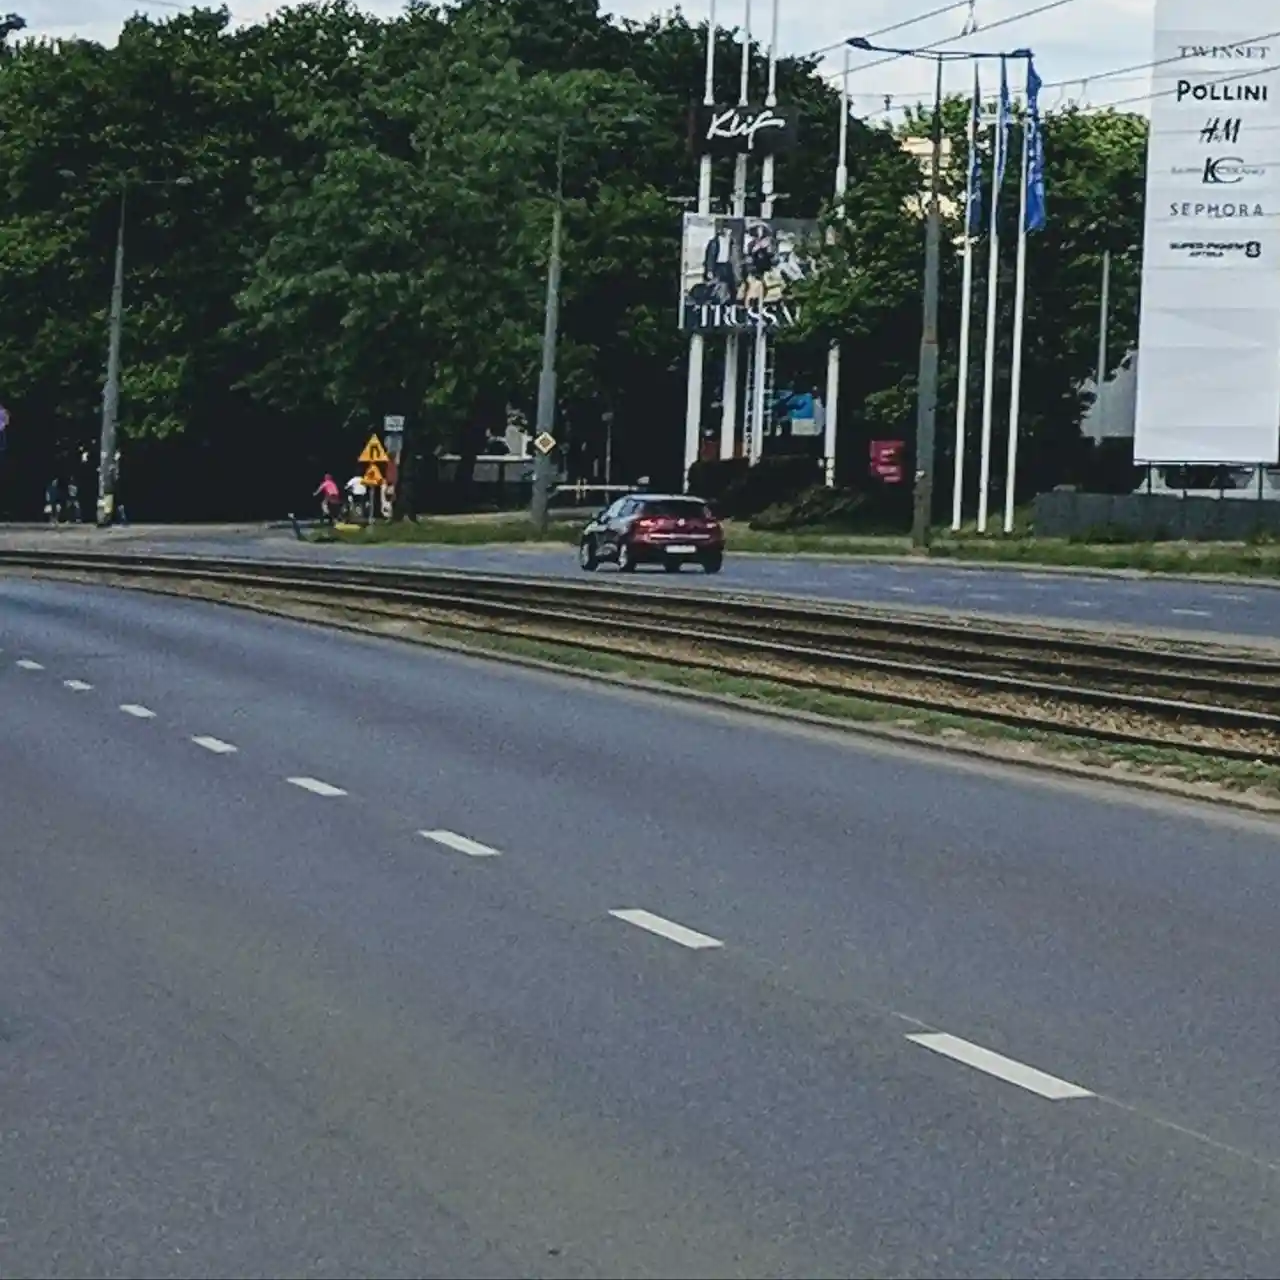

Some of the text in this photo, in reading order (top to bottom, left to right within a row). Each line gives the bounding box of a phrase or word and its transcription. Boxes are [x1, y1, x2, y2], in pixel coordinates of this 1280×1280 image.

[1176, 79, 1268, 103] POLLINI
[705, 108, 786, 150] Klif
[1169, 202, 1264, 218] SEPHORA
